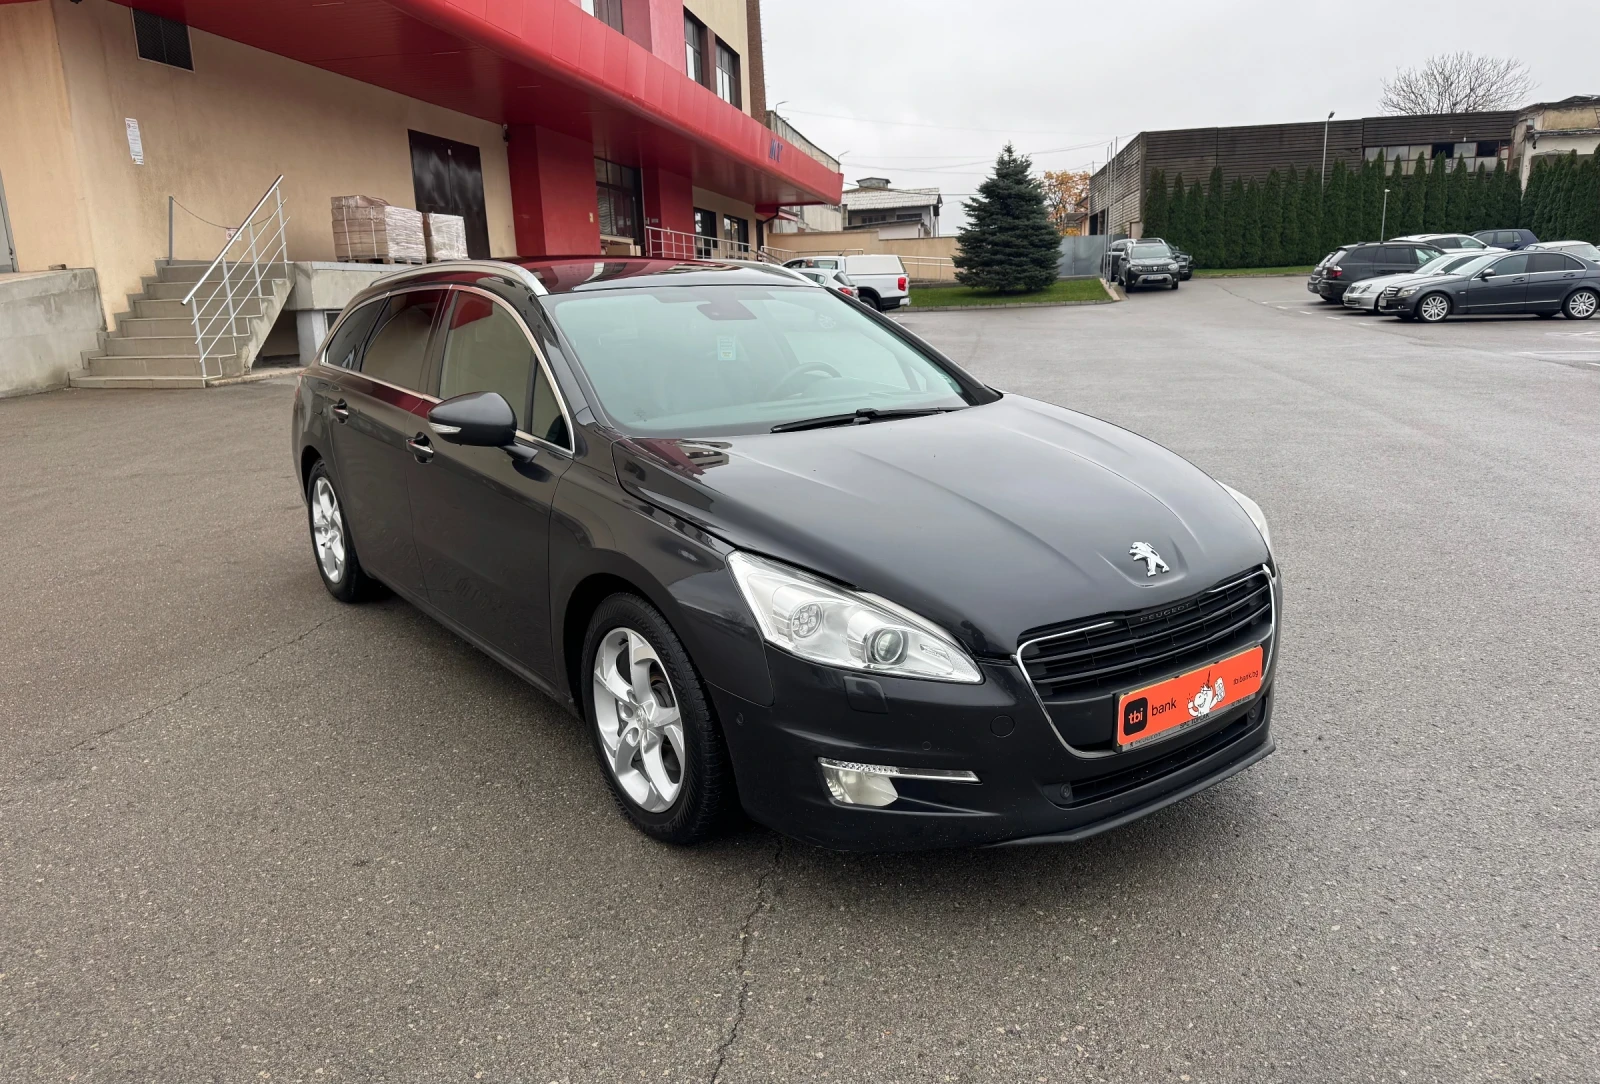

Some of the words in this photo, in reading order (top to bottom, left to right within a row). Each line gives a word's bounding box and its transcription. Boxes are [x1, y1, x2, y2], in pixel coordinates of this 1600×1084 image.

[1140, 602, 1190, 622] PEUGEOT
[1128, 708, 1144, 725] tbi
[1151, 697, 1177, 716] bank
